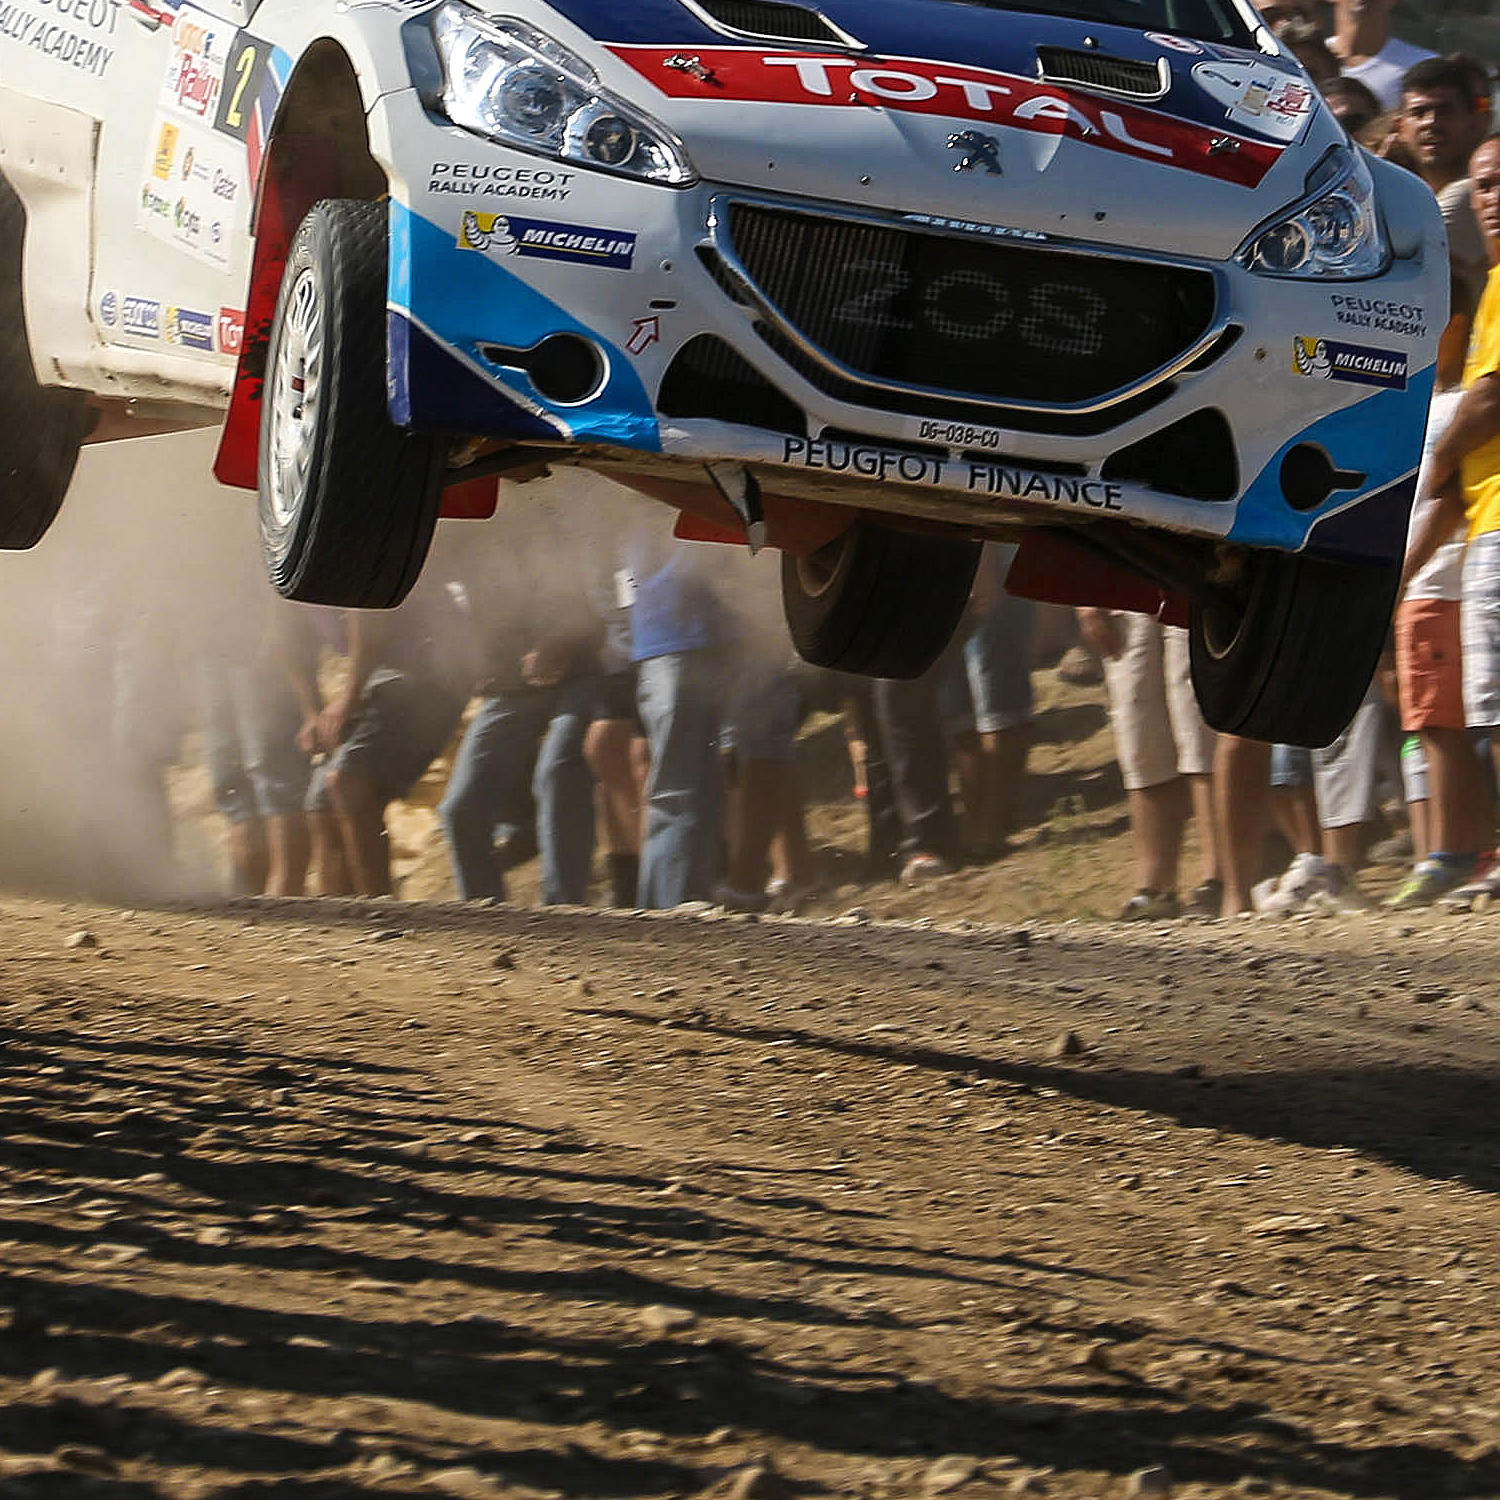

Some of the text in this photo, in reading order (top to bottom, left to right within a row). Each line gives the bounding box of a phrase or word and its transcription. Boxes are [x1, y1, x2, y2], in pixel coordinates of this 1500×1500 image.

[27, 20, 116, 77] ACADEMY
[225, 44, 257, 129] 2
[763, 56, 1175, 157] TOTAL
[430, 162, 576, 187] PEUGEOT
[427, 179, 571, 201] RALLY ACADEMY
[521, 228, 635, 256] MICHELIN
[1330, 294, 1425, 322] PEUGEOT
[1334, 352, 1408, 376] MICHELIN
[967, 464, 1124, 512] FINANCE
